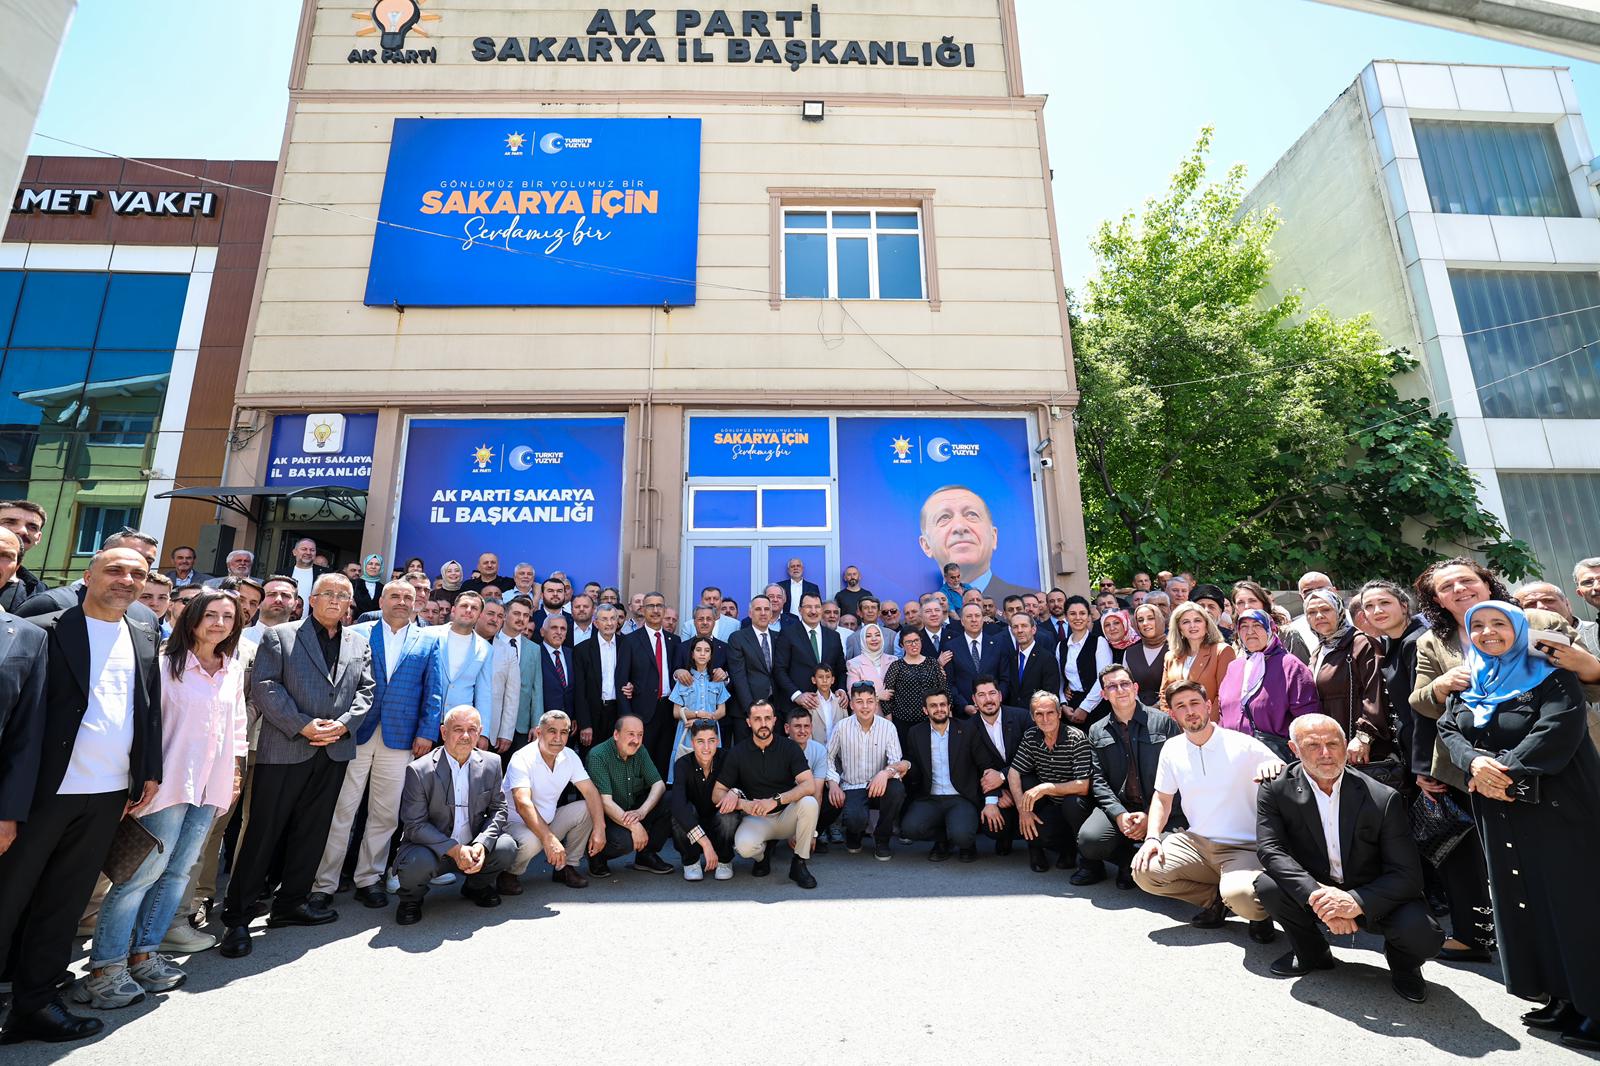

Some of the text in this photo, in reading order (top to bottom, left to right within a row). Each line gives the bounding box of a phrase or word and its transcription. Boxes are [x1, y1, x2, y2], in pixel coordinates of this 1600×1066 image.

[586, 4, 820, 38] AK PARTİ
[347, 46, 437, 64] AK PARTİ
[471, 36, 665, 63] SAKARYA
[727, 35, 975, 72] BAŞKANLIĞI
[440, 179, 645, 188] GÖNLÜMÜZ BİR YOLUMUZ BİR
[16, 188, 217, 217] MET VAKFI
[419, 190, 658, 219] SAKARYA İÇİN
[462, 215, 612, 254] Sevdamız bir
[714, 432, 809, 446] SAKARYA İÇİN
[273, 455, 373, 465] AK PARTİ SAKARYA
[775, 444, 792, 458] bir
[288, 465, 372, 479] BAŞKANLIĞI
[432, 488, 595, 502] AK PARTİ SAKARYA
[455, 502, 594, 526] BAŞKANLIĞI
